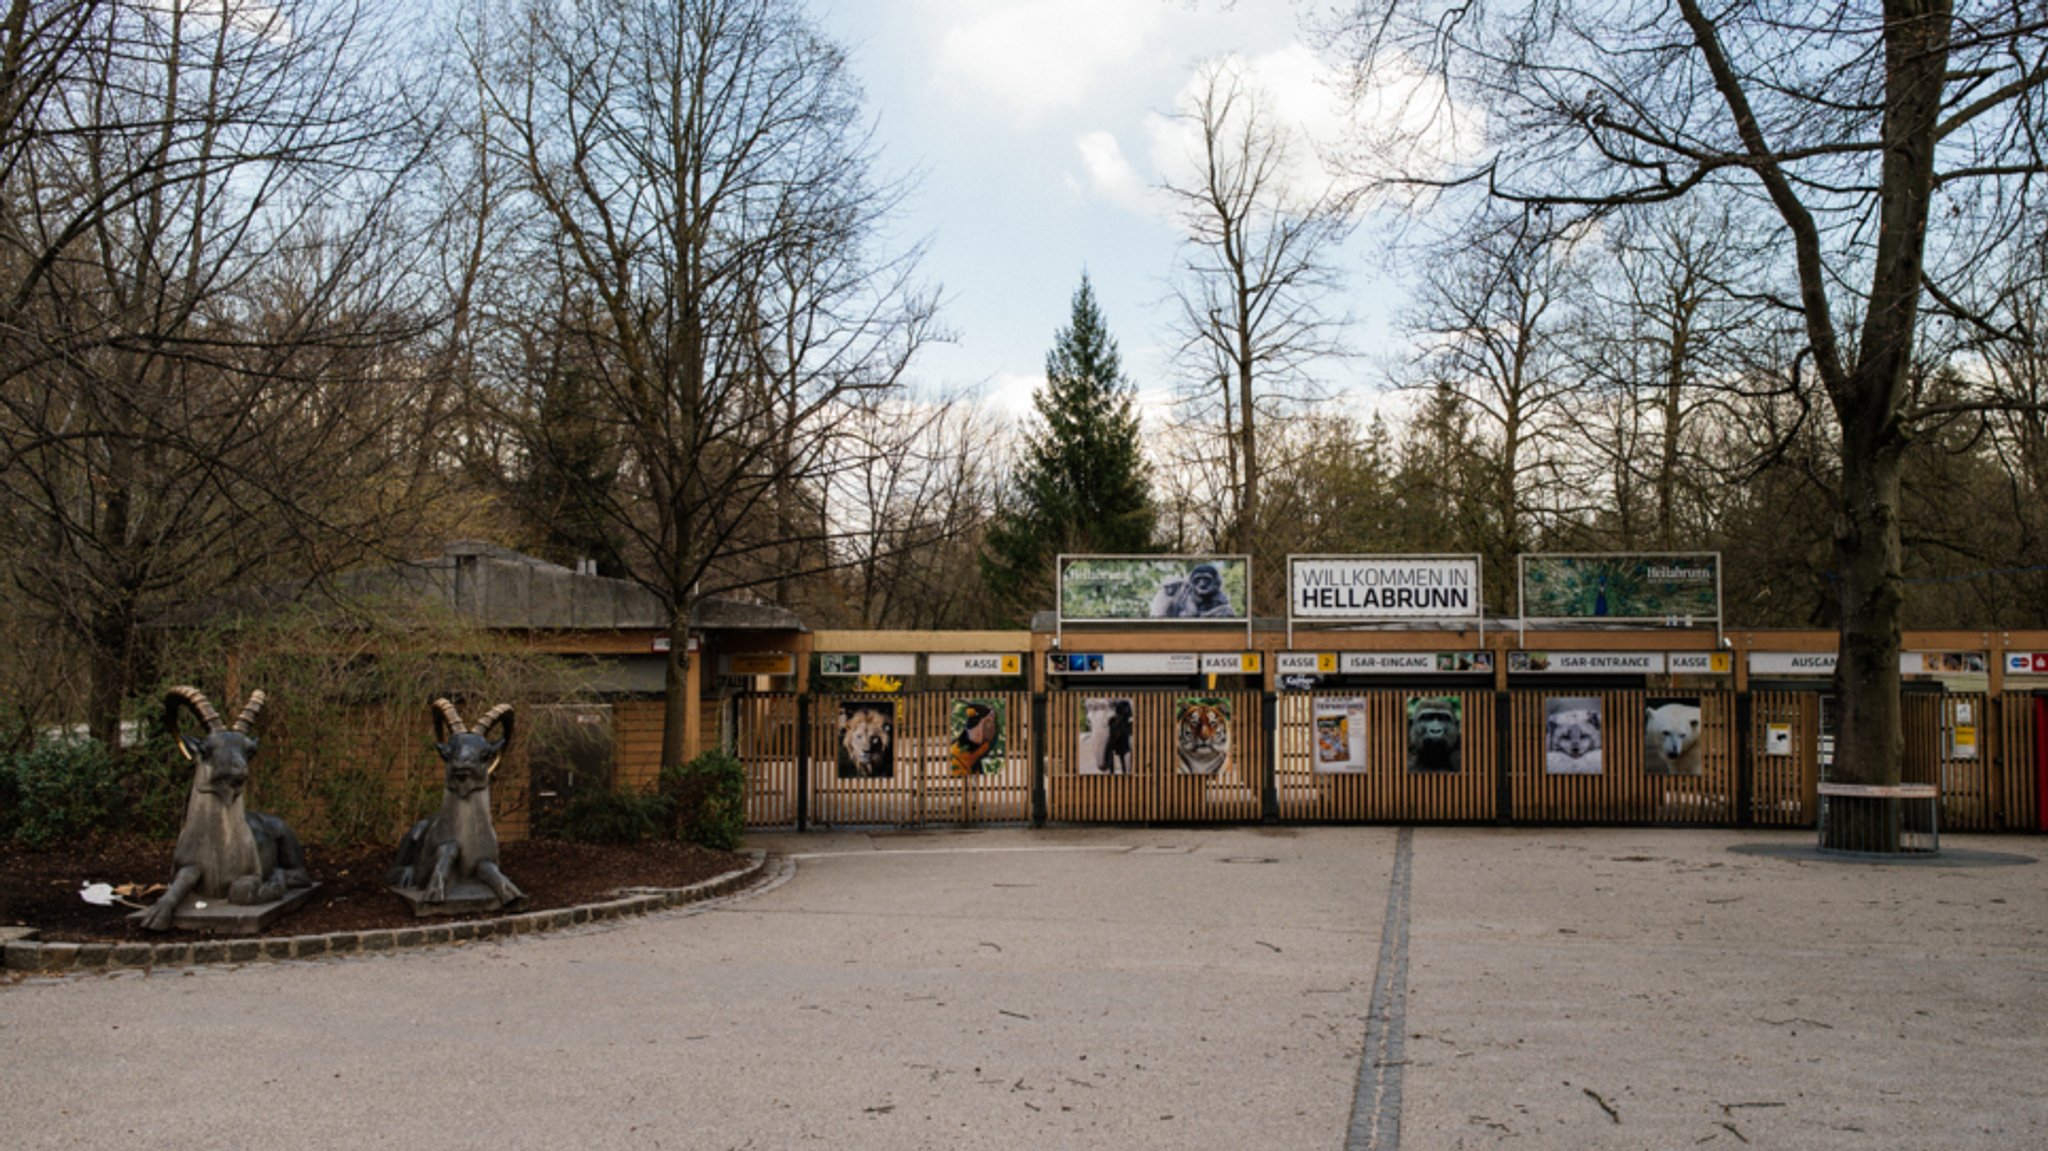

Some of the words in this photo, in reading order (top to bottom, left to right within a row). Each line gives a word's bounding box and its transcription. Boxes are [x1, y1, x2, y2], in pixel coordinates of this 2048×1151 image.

[1302, 568, 1442, 586] WILLKOMMEN
[1450, 568, 1468, 586] IN
[1647, 566, 1711, 579] Hellabrunn
[1302, 588, 1468, 608] HELLABRUNN
[965, 659, 998, 669] KASSE
[1007, 659, 1013, 668] 4
[1206, 657, 1238, 667] KASSE
[1282, 657, 1315, 667] KASSE
[1324, 657, 1331, 667] 2
[1350, 657, 1428, 667] ISAR-EINGANG
[1560, 657, 1650, 667] ISAR-ENTRANCE
[1672, 657, 1707, 667] KASSE
[1717, 657, 1723, 667] 1
[1791, 657, 1837, 667] AUSGAN
